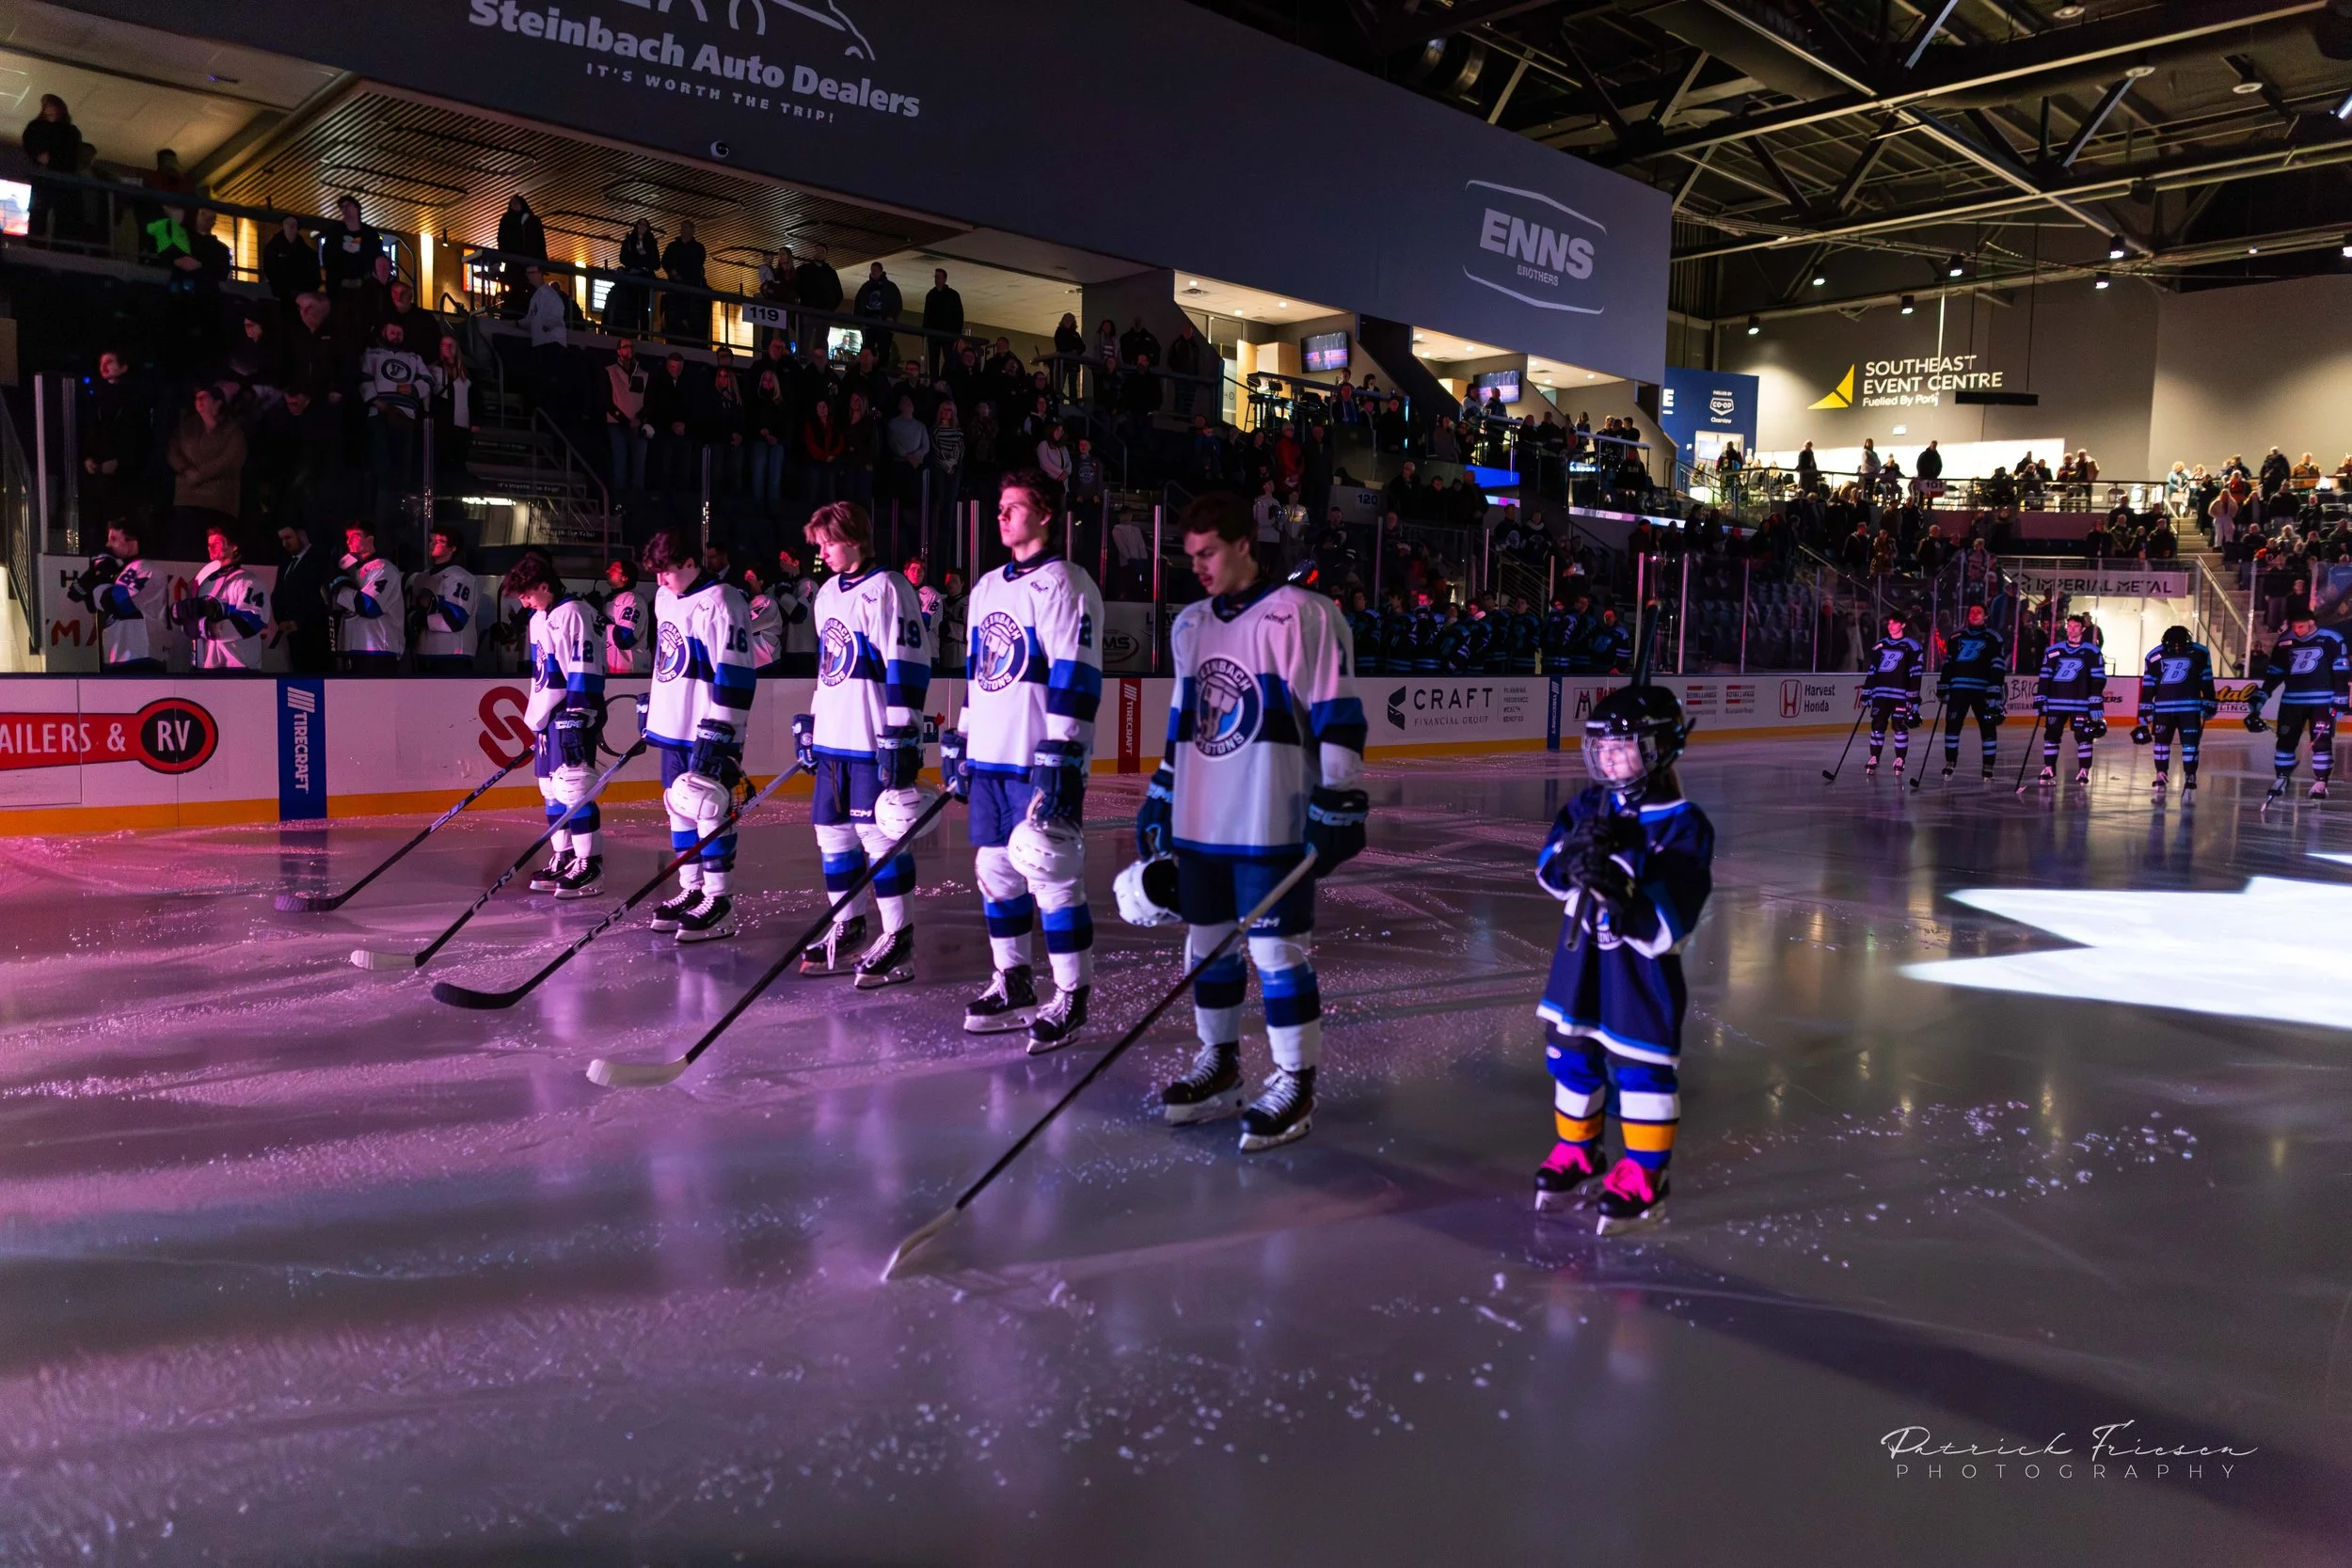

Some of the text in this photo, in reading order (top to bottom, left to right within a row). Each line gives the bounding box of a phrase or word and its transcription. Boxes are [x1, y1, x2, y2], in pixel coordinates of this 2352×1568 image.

[469, 0, 920, 118] Steinbach Auto Dealers
[586, 62, 834, 123] IT'S WORTH THE TRIP!
[1479, 208, 1595, 279] ENNS
[1517, 264, 1559, 286] BROTHERS
[750, 307, 779, 322] 119
[1865, 355, 1977, 376] SOUTHEAST
[1863, 372, 2003, 394] EVENT CENTRE
[1863, 396, 1898, 407] Fuelled
[1899, 395, 1914, 406] By
[1358, 494, 1377, 505] 120
[373, 578, 388, 594] 4
[453, 582, 469, 602] 18
[2036, 578, 2171, 594] IMPERIAL METAL
[245, 587, 264, 608] 14
[622, 607, 641, 624] 22
[726, 625, 748, 653] 16
[897, 617, 921, 648] 19
[572, 641, 593, 662] 12
[1413, 688, 1493, 710] CRAFT
[1804, 684, 1836, 696] Harvest
[1804, 700, 1829, 712] Honda
[1125, 701, 1134, 755] TIRECRAFT
[1414, 716, 1488, 726] FINANCIAL GROUP
[107, 722, 125, 752] &
[158, 720, 191, 752] RV
[293, 712, 310, 792] TIRECRAFT
